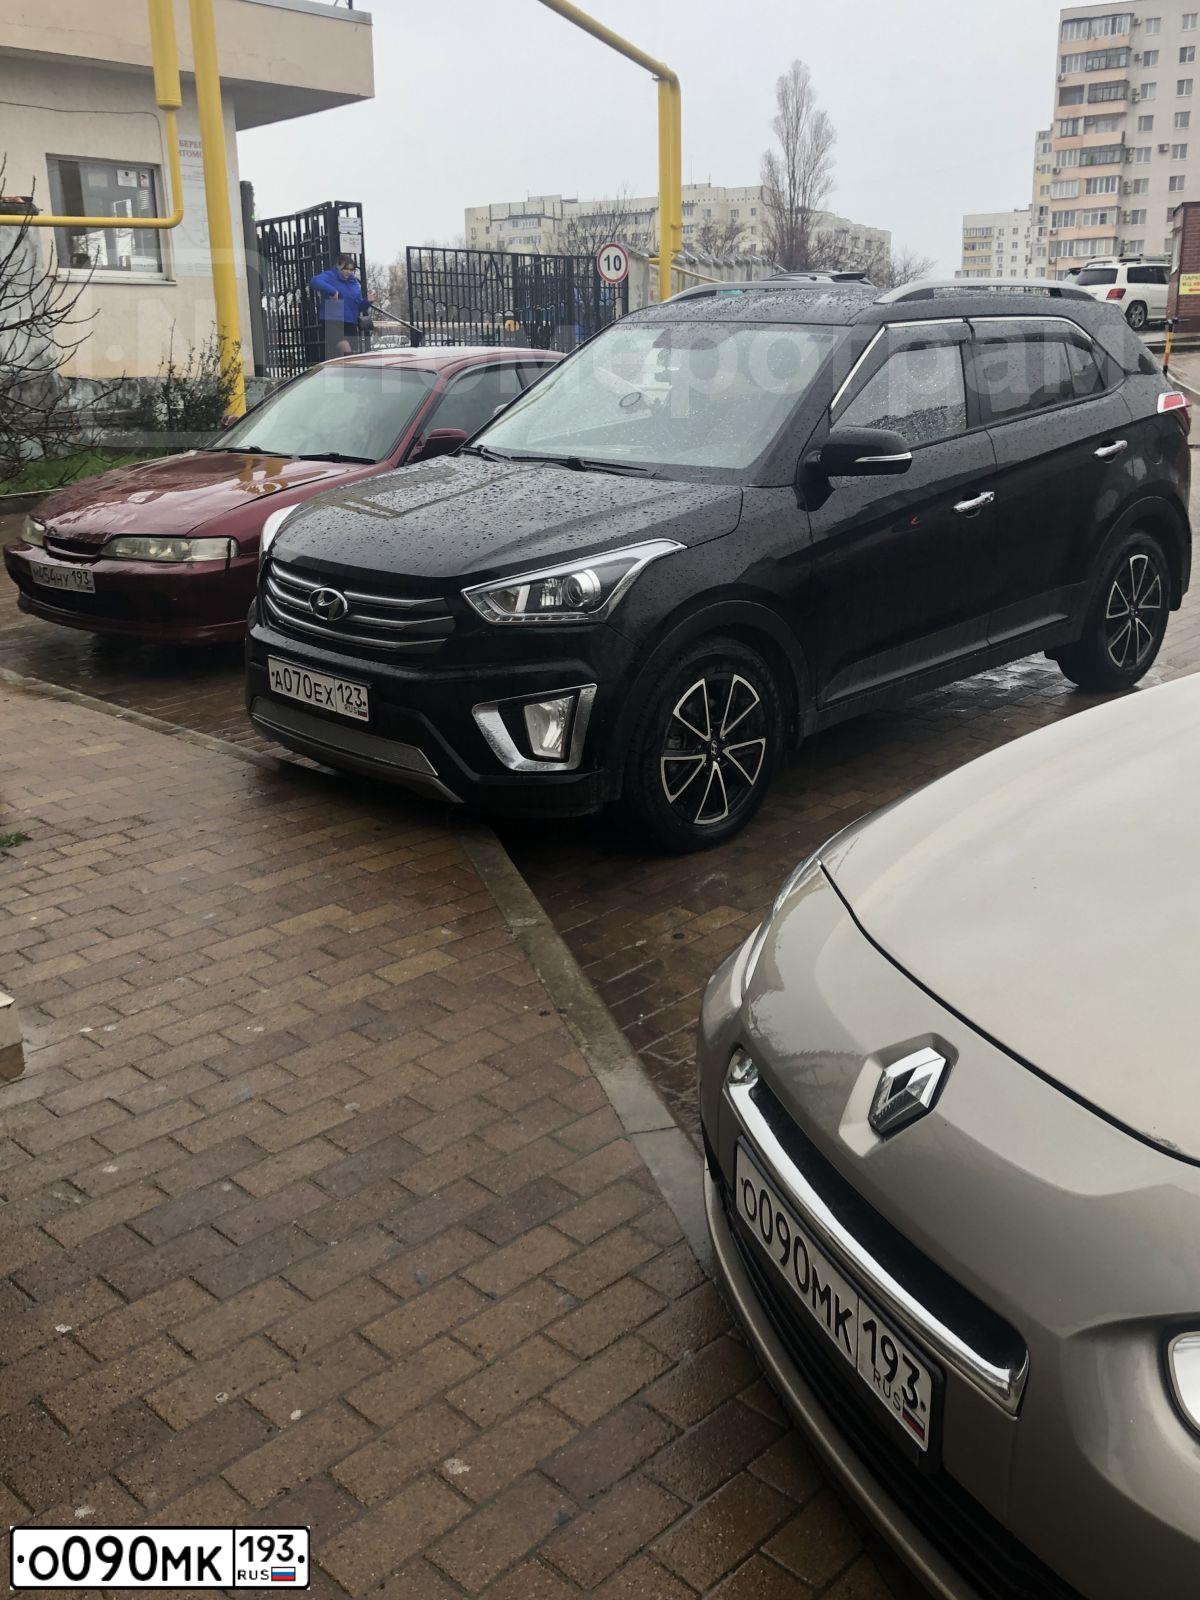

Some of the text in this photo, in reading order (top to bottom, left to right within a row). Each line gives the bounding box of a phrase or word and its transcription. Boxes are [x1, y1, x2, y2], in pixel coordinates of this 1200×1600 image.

[604, 254, 622, 271] 10
[72, 571, 89, 585] 193
[275, 668, 363, 707] А070ЕХ 123
[743, 1178, 919, 1411] О090МК 193
[873, 1367, 901, 1411] RUS
